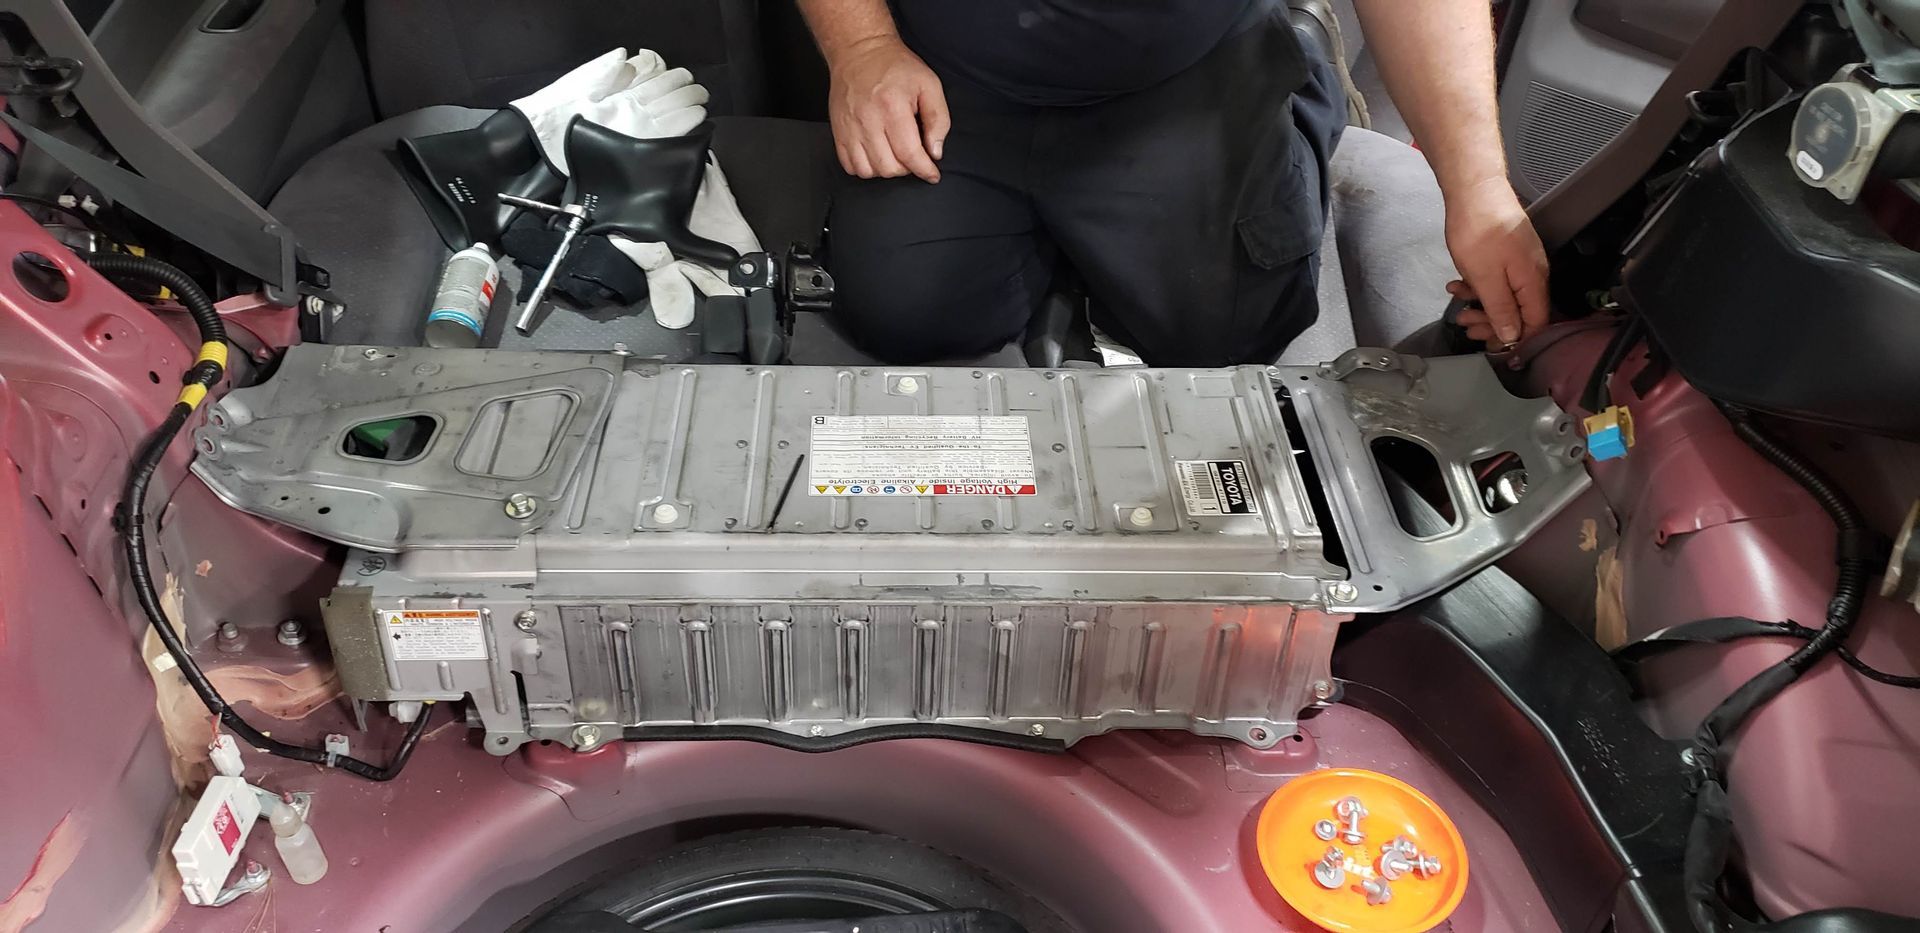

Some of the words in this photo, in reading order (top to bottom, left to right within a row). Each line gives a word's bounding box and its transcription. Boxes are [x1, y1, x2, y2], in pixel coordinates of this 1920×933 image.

[814, 416, 825, 425] B
[946, 485, 1006, 494] DANGER
[1221, 467, 1243, 505] TOYOTA
